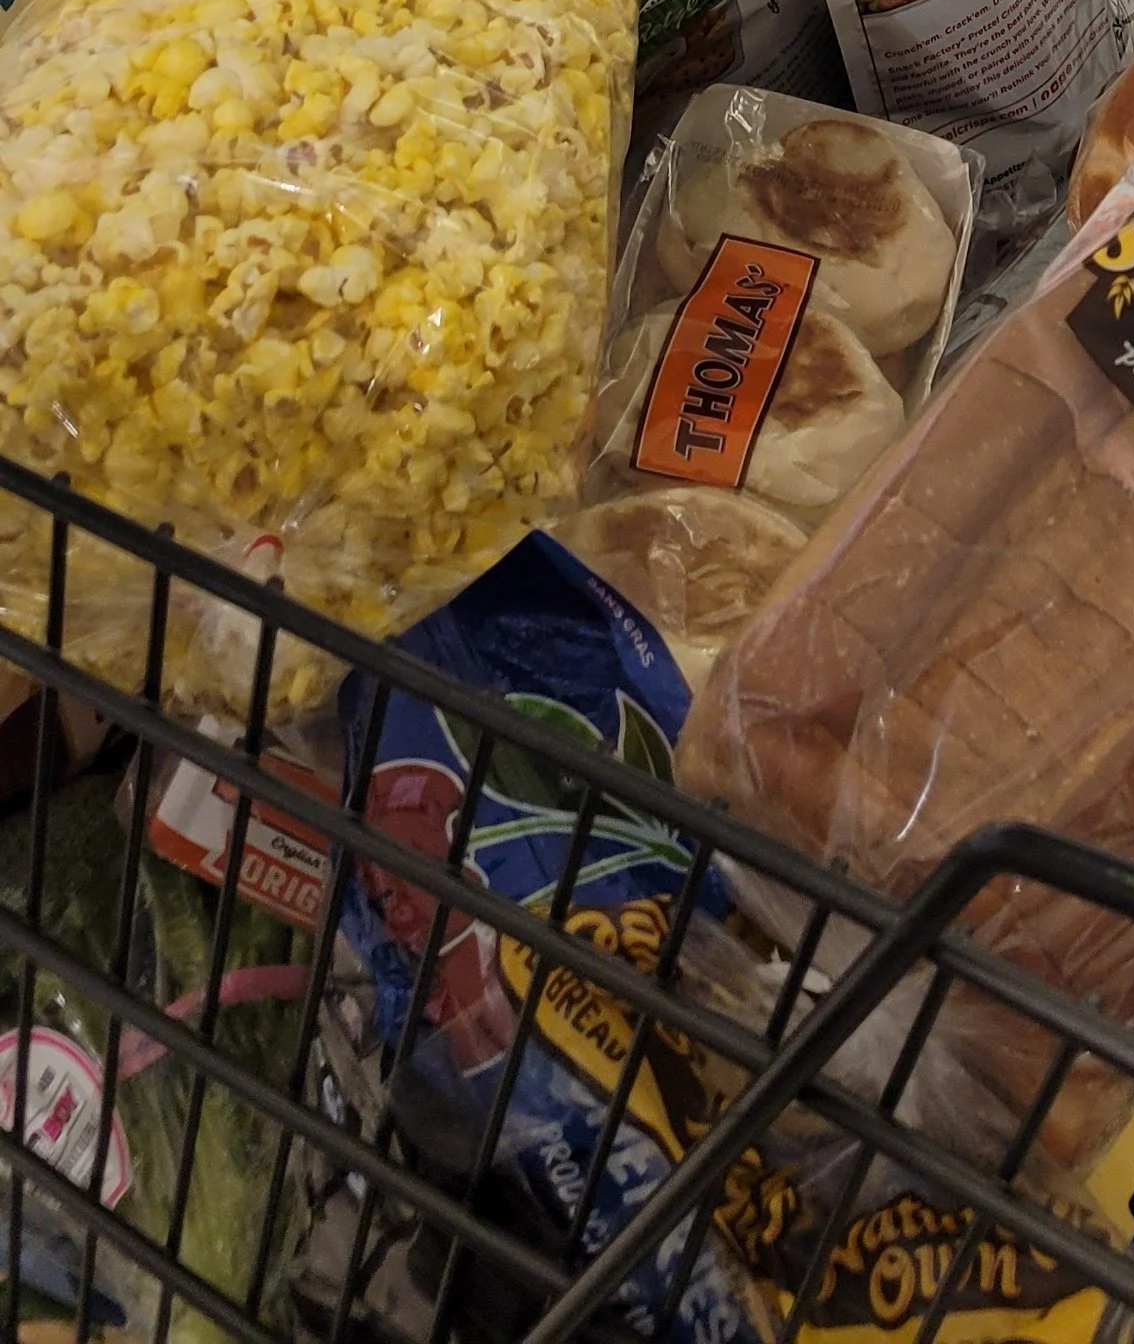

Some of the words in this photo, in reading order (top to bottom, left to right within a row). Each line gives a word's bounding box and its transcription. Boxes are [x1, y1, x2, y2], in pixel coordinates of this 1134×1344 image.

[884, 31, 941, 60] Crunch'em.
[944, 4, 991, 36] Crack'em.
[952, 37, 990, 62] They're
[990, 29, 1006, 45] the
[1006, 13, 1024, 33] best
[967, 17, 1000, 43] Pretzel
[962, 58, 980, 72] the
[980, 39, 1013, 63] crunch
[980, 52, 1013, 78] paired
[953, 80, 982, 99] enjoy
[982, 71, 1002, 87] this
[1000, 71, 1035, 96] Rethink
[622, 617, 655, 669] GRAS
[241, 852, 323, 914] ORIG
